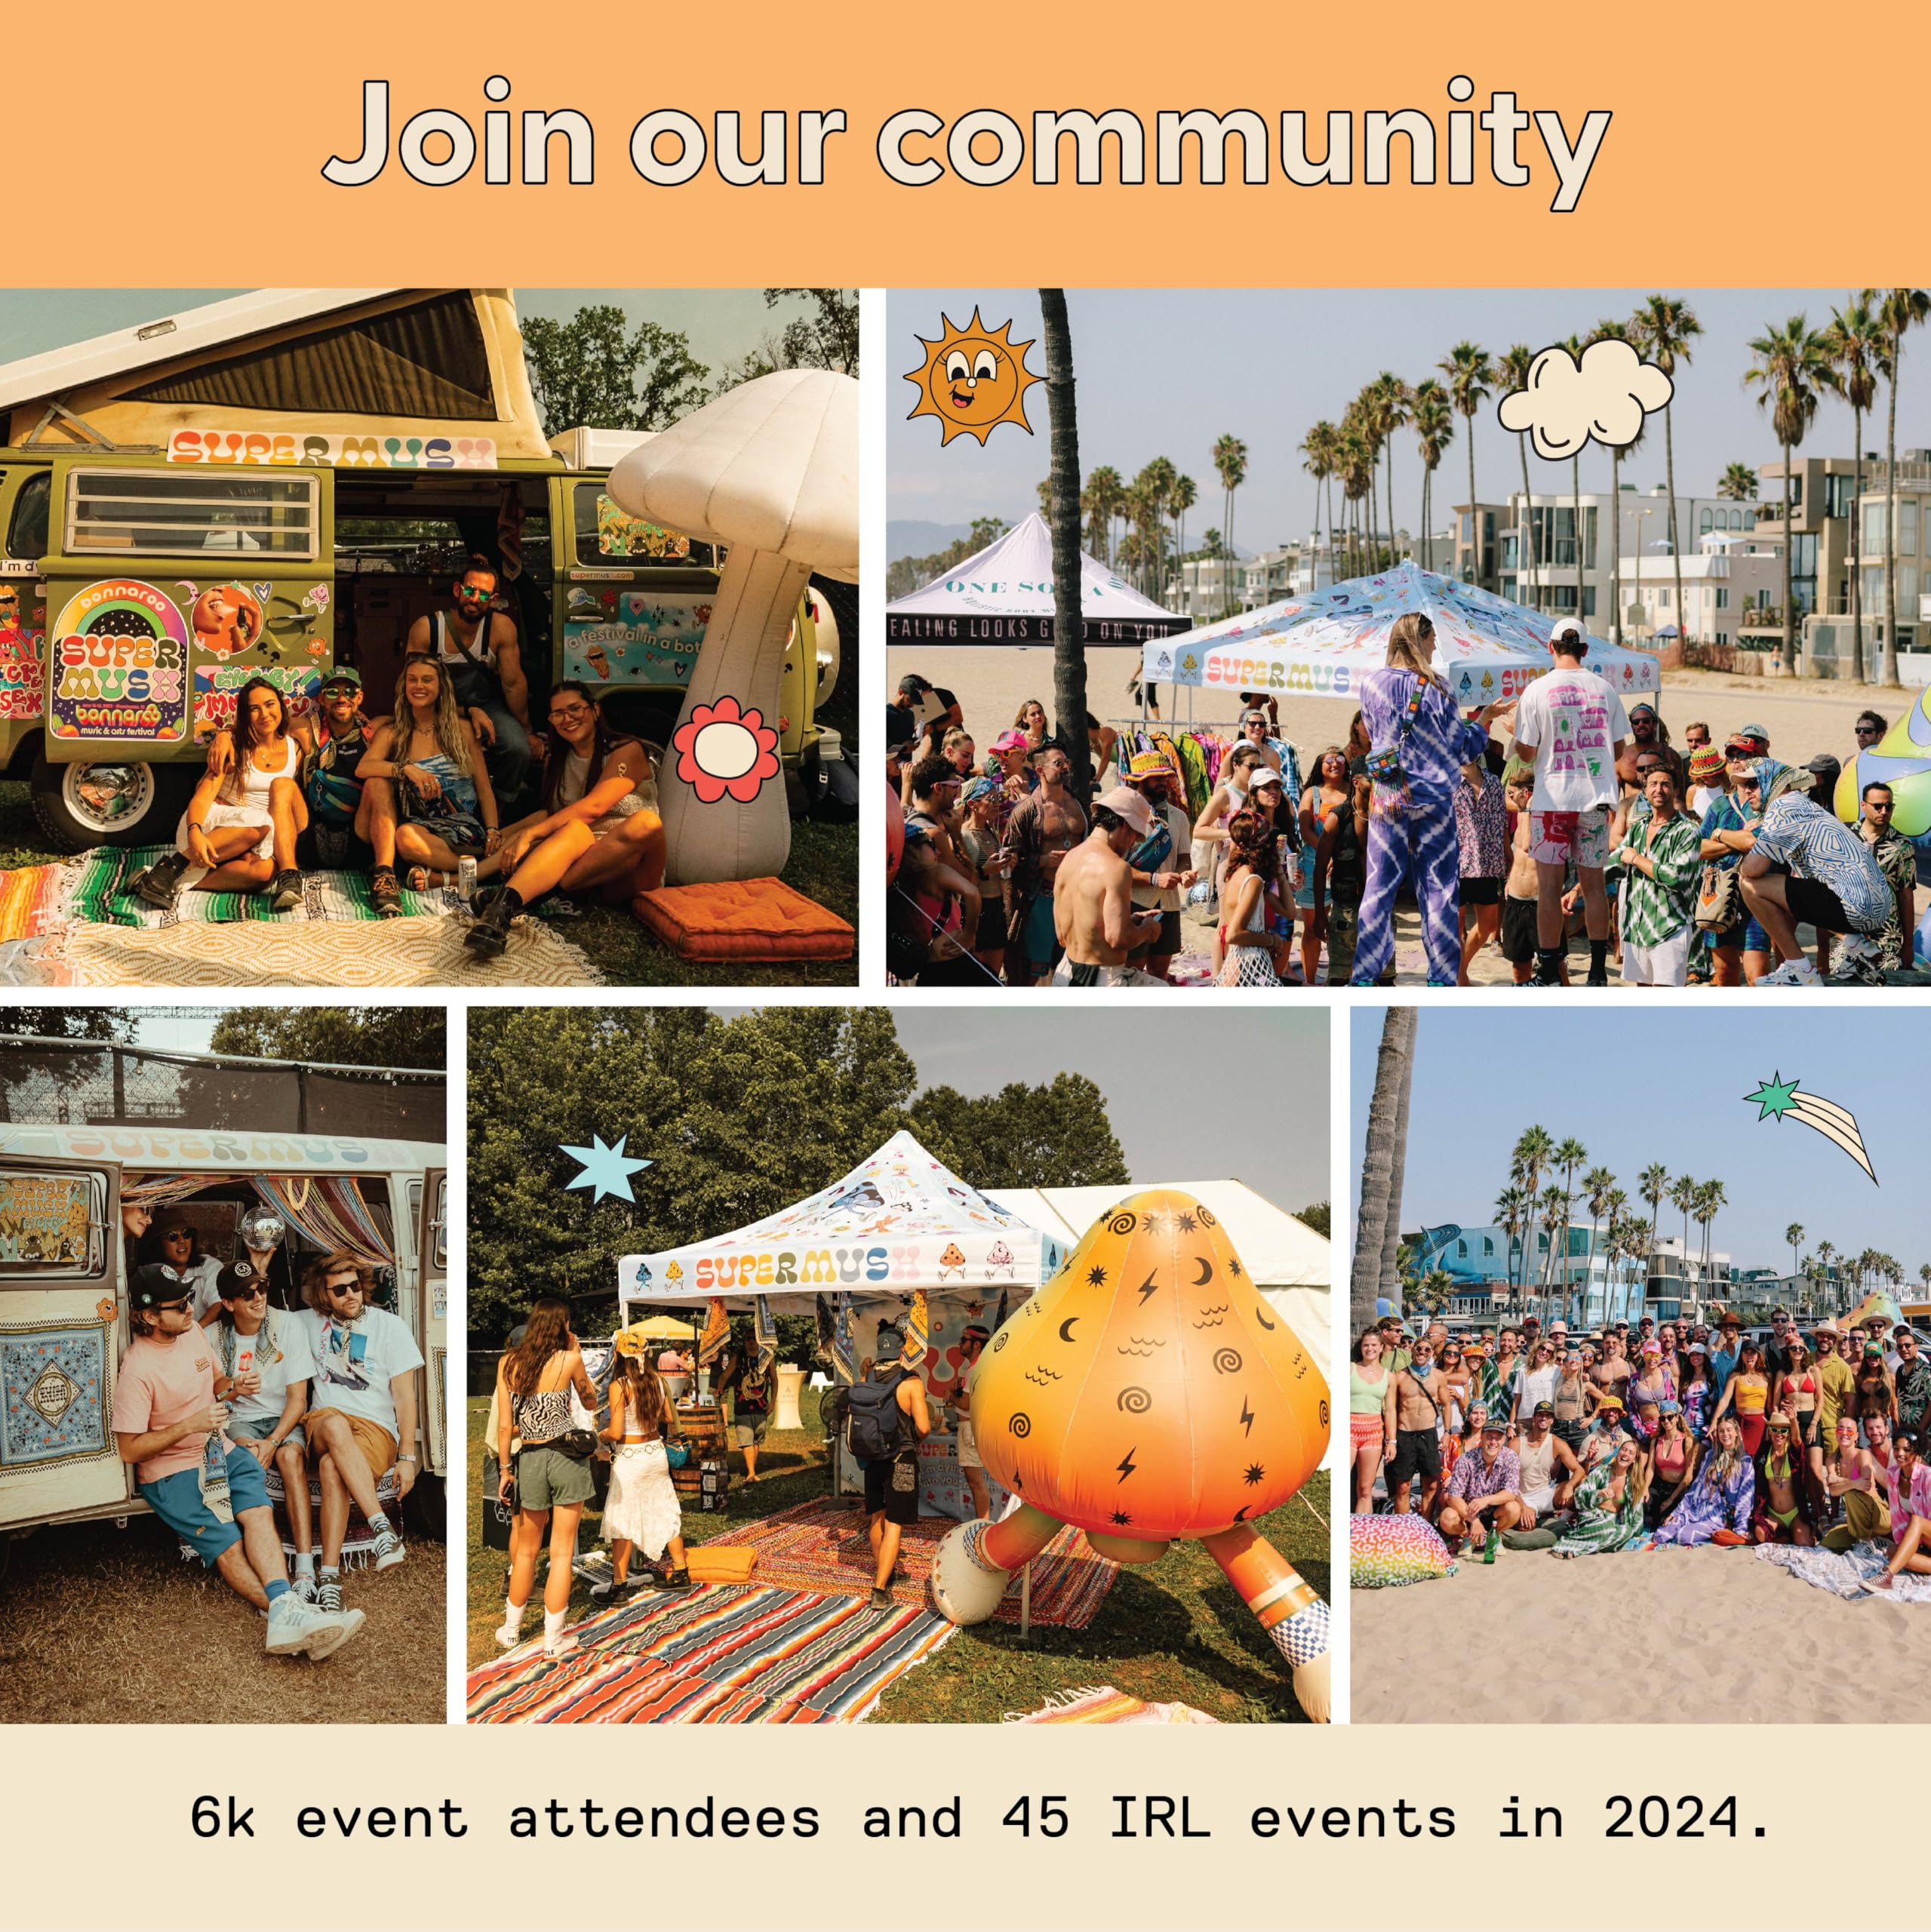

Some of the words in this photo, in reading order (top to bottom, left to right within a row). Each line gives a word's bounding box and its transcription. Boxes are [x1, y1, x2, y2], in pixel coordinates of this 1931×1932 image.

[0, 561, 20, 571] I'm
[946, 580, 1007, 594] ONE
[80, 586, 166, 611] bonnaroo
[567, 637, 580, 649] a
[581, 627, 640, 642] festival
[643, 631, 658, 646] in
[660, 638, 670, 650] a
[970, 618, 1029, 638] LOOKS
[1099, 622, 1123, 640] ON
[1134, 624, 1168, 640] YOU
[62, 635, 180, 669] SUPER
[60, 667, 180, 700] MUSH
[81, 726, 102, 734] music
[127, 728, 155, 736] festival
[12, 1179, 68, 1200] SUPER
[11, 1198, 68, 1220] MUSH
[696, 1244, 921, 1289] SUPERMUSH
[938, 1463, 965, 1477] dying
